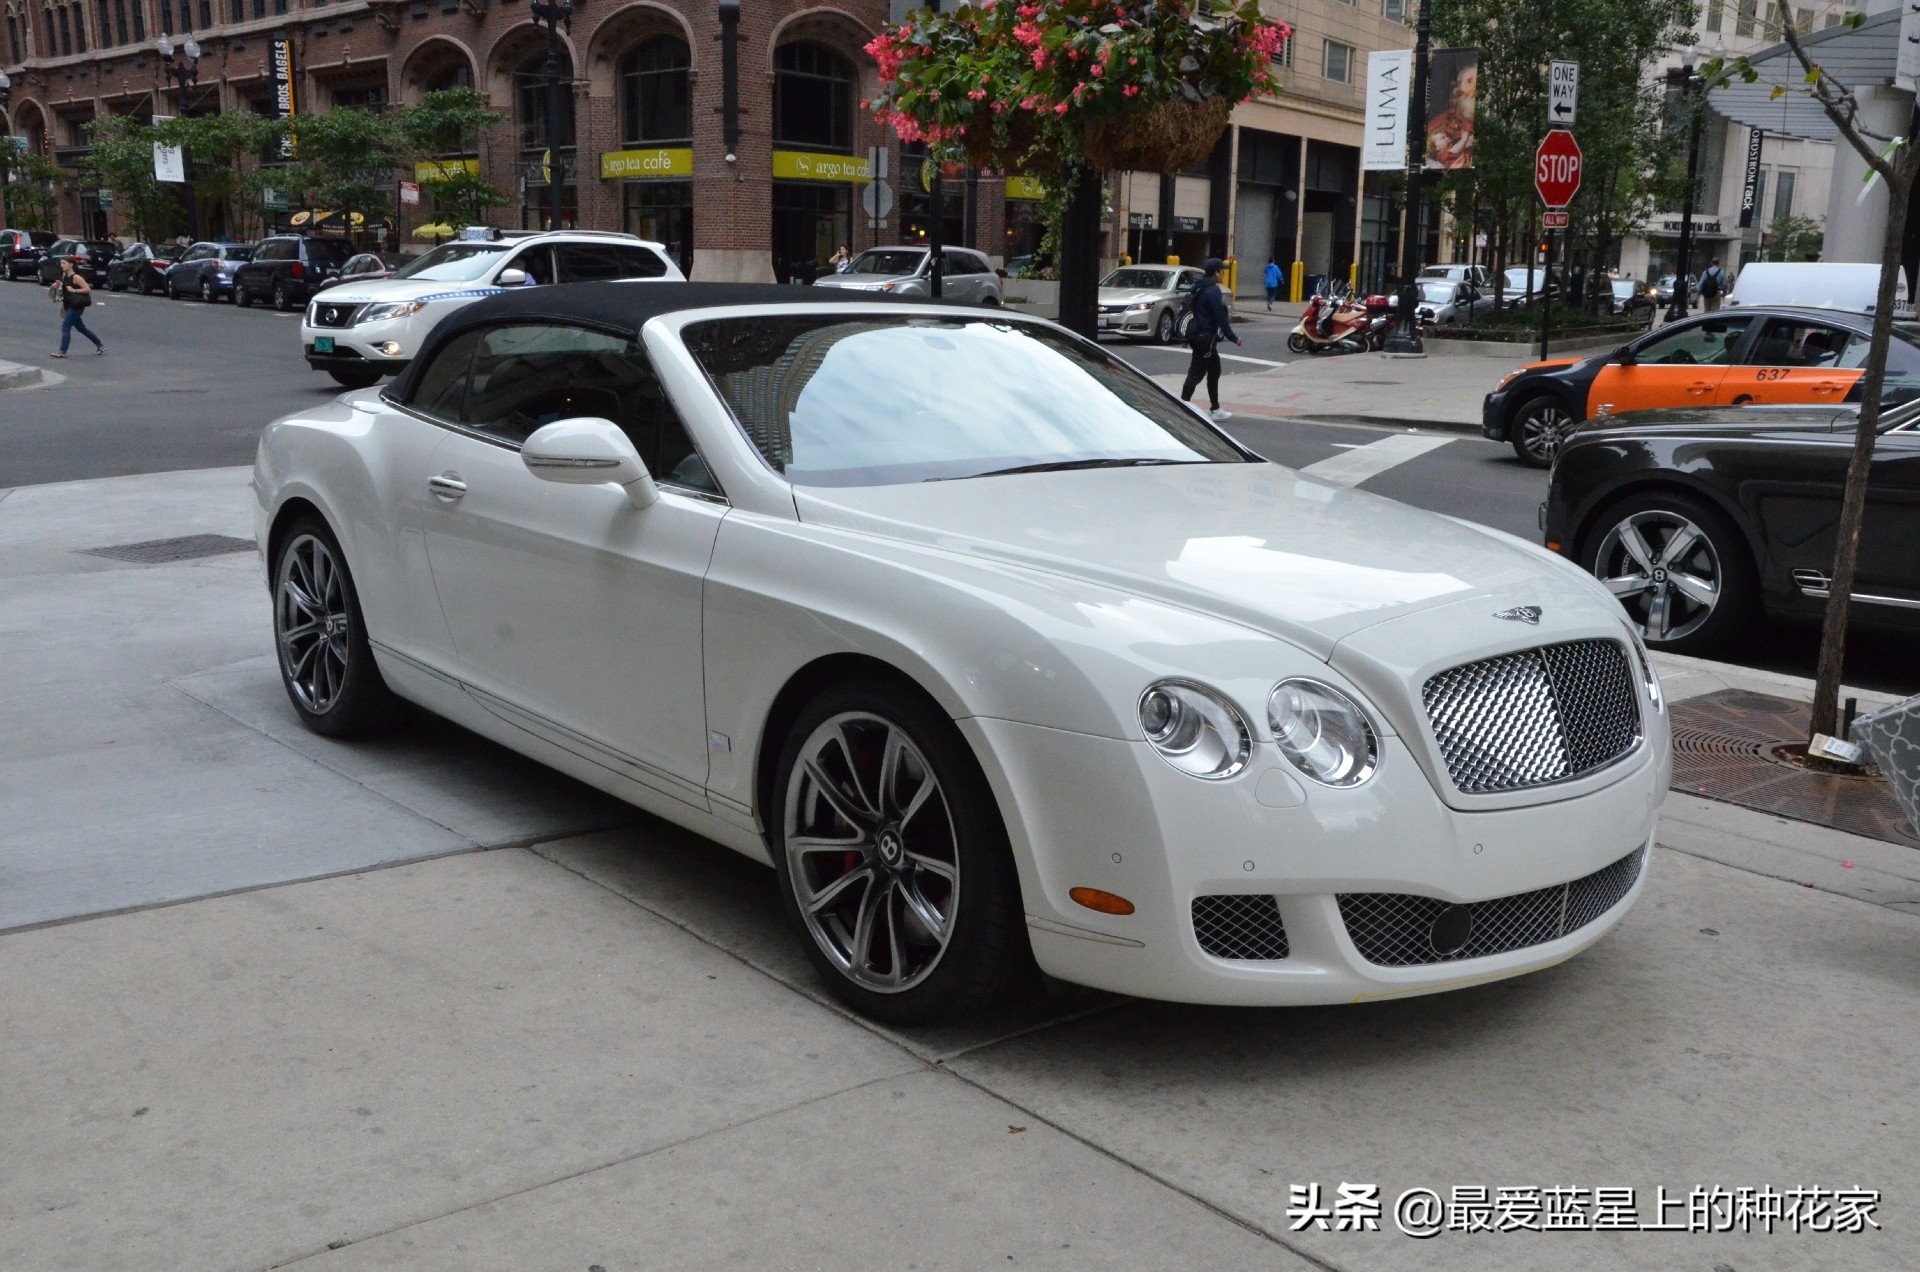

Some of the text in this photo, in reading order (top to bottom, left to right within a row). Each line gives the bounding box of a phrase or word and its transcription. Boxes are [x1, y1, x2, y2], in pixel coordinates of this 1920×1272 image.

[274, 41, 289, 80] BAGELS
[1554, 66, 1576, 82] ONE
[277, 82, 290, 110] BROS.
[1553, 84, 1576, 99] WAY
[1376, 66, 1399, 147] LUMA
[610, 150, 672, 175] argo tea café
[816, 162, 841, 178] argo
[843, 162, 856, 176] tea
[1538, 154, 1578, 183] STOP
[1742, 130, 1760, 211] ORDSTROM rack
[1544, 215, 1567, 225] ALL WAY
[1756, 368, 1791, 381] 637
